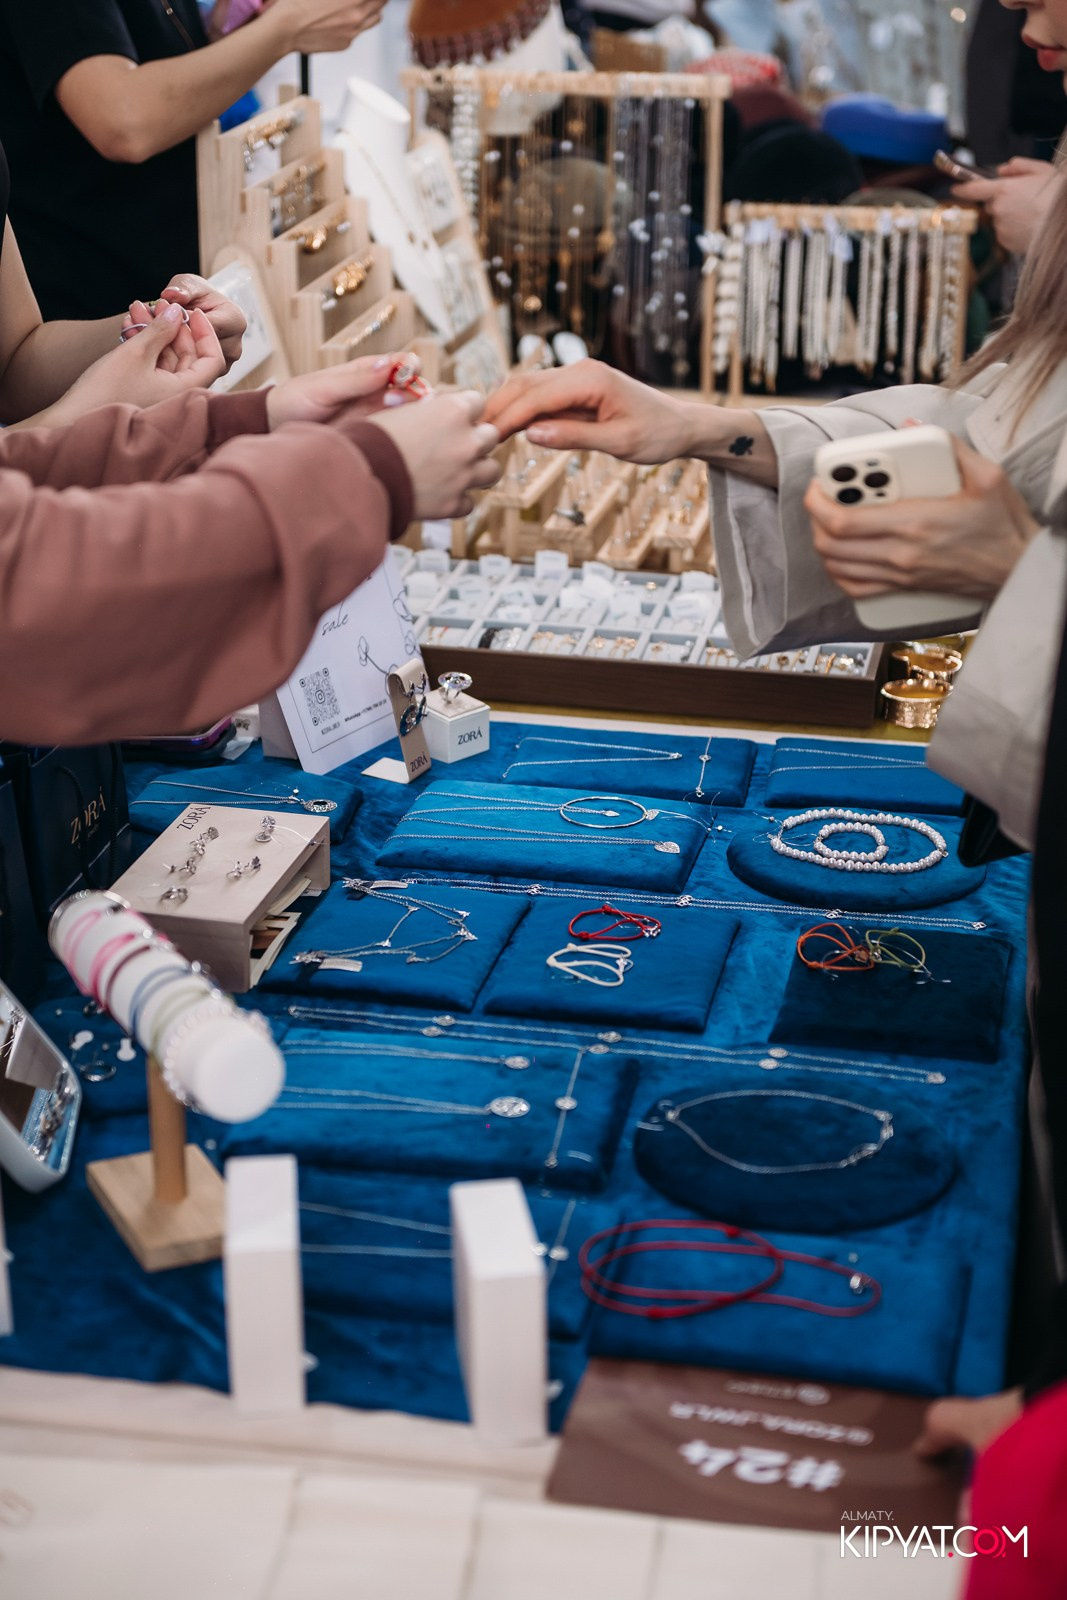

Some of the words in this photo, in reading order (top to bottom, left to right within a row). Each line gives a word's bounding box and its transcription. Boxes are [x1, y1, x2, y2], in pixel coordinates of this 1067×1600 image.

[321, 600, 349, 636] sale
[457, 726, 483, 746] ZORÁ
[409, 752, 428, 773] ZORÁ
[176, 806, 212, 830] ZORÁ
[678, 1439, 846, 1493] #24
